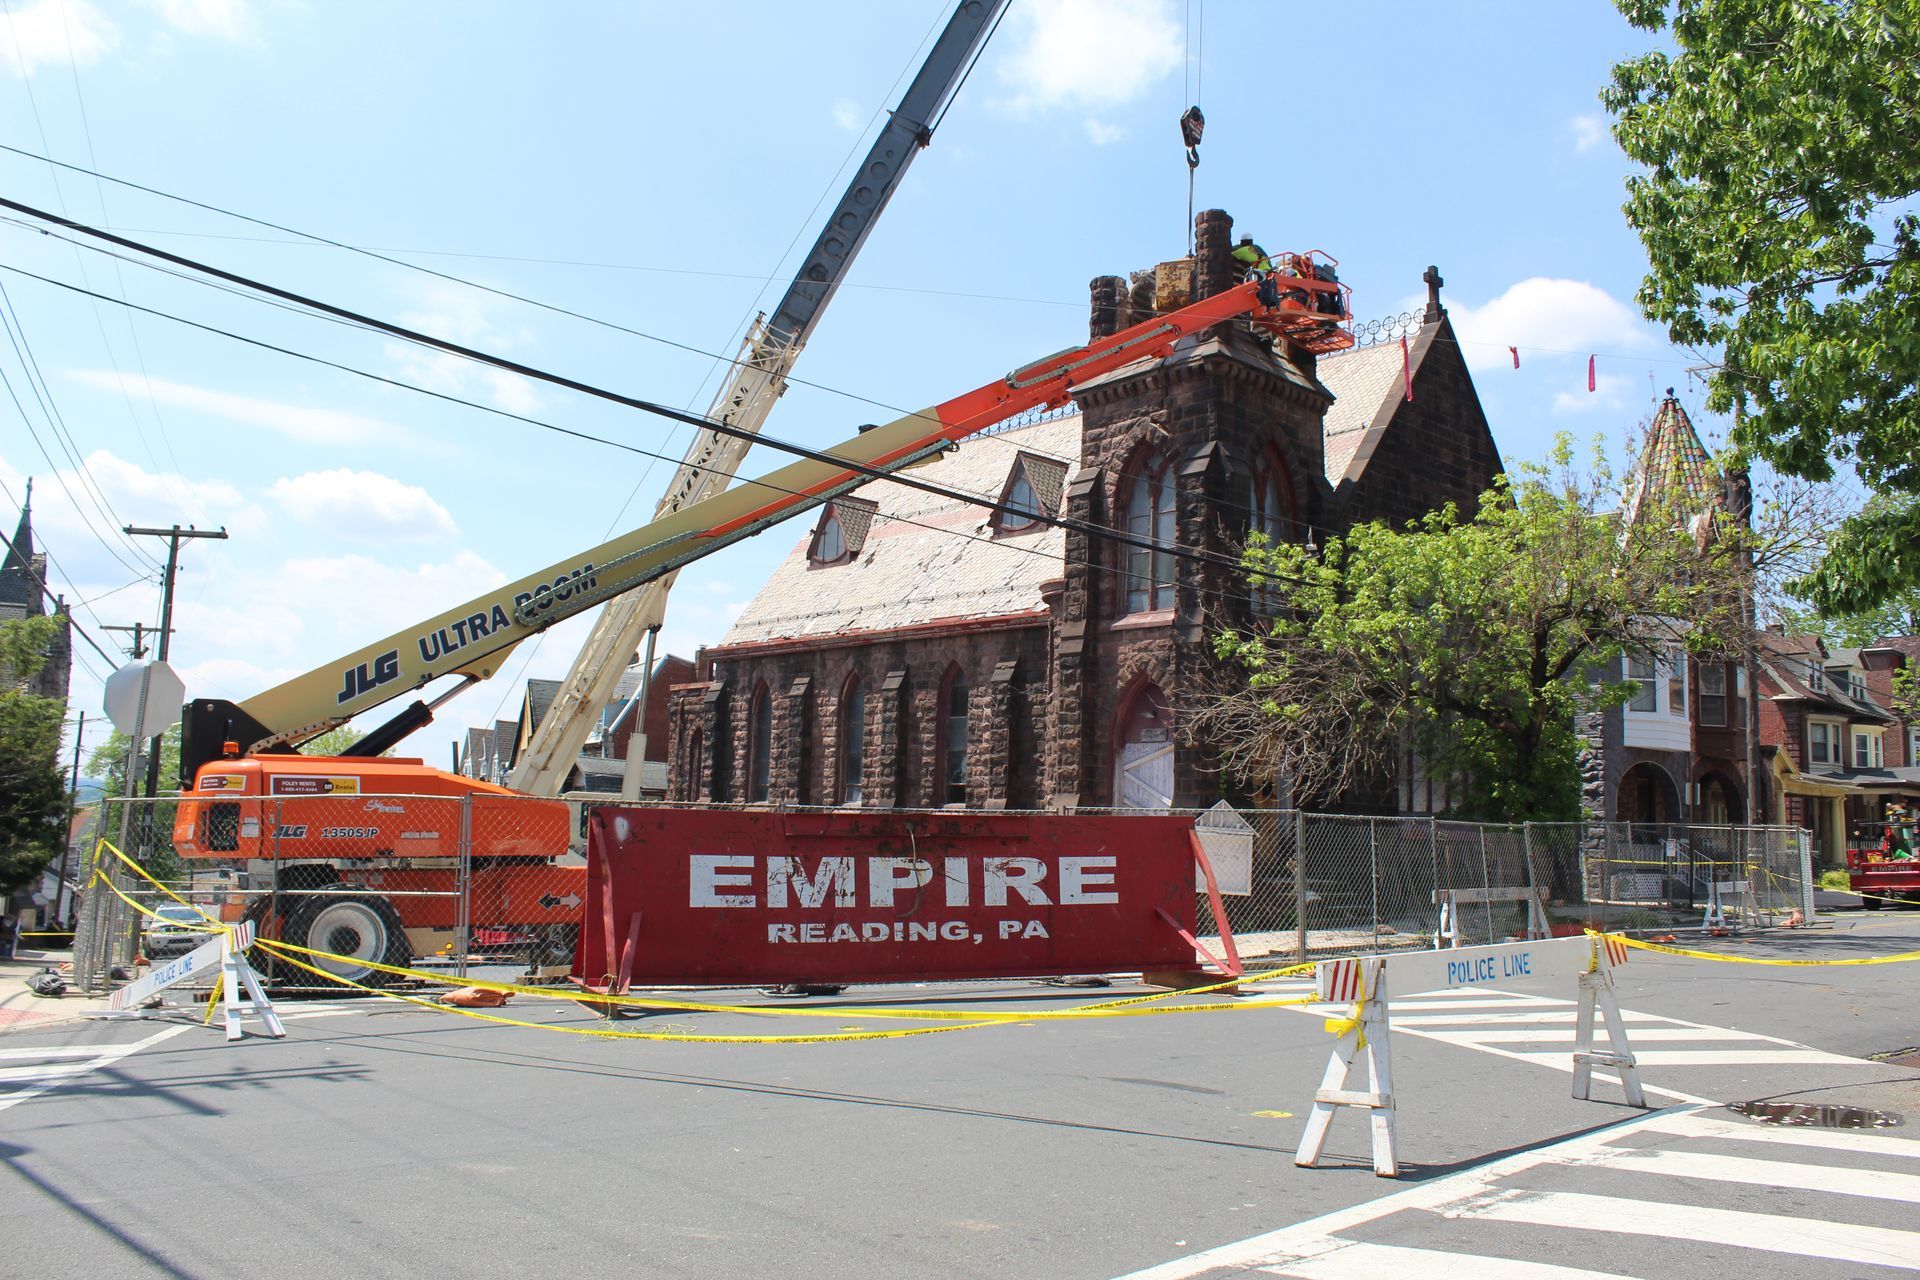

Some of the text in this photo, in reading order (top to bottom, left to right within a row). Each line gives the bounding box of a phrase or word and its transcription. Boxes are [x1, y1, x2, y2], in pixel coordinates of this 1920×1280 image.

[337, 648, 399, 704] JLG
[418, 603, 511, 663] ULTRA
[272, 825, 379, 838] JLG 1350SJP
[690, 854, 1119, 908] EMPIRE
[1871, 865, 1913, 873] EMPIRE
[767, 920, 1050, 945] READING, PA
[154, 956, 193, 987] POLICE LINE
[1447, 953, 1531, 985] POLICE LINE
